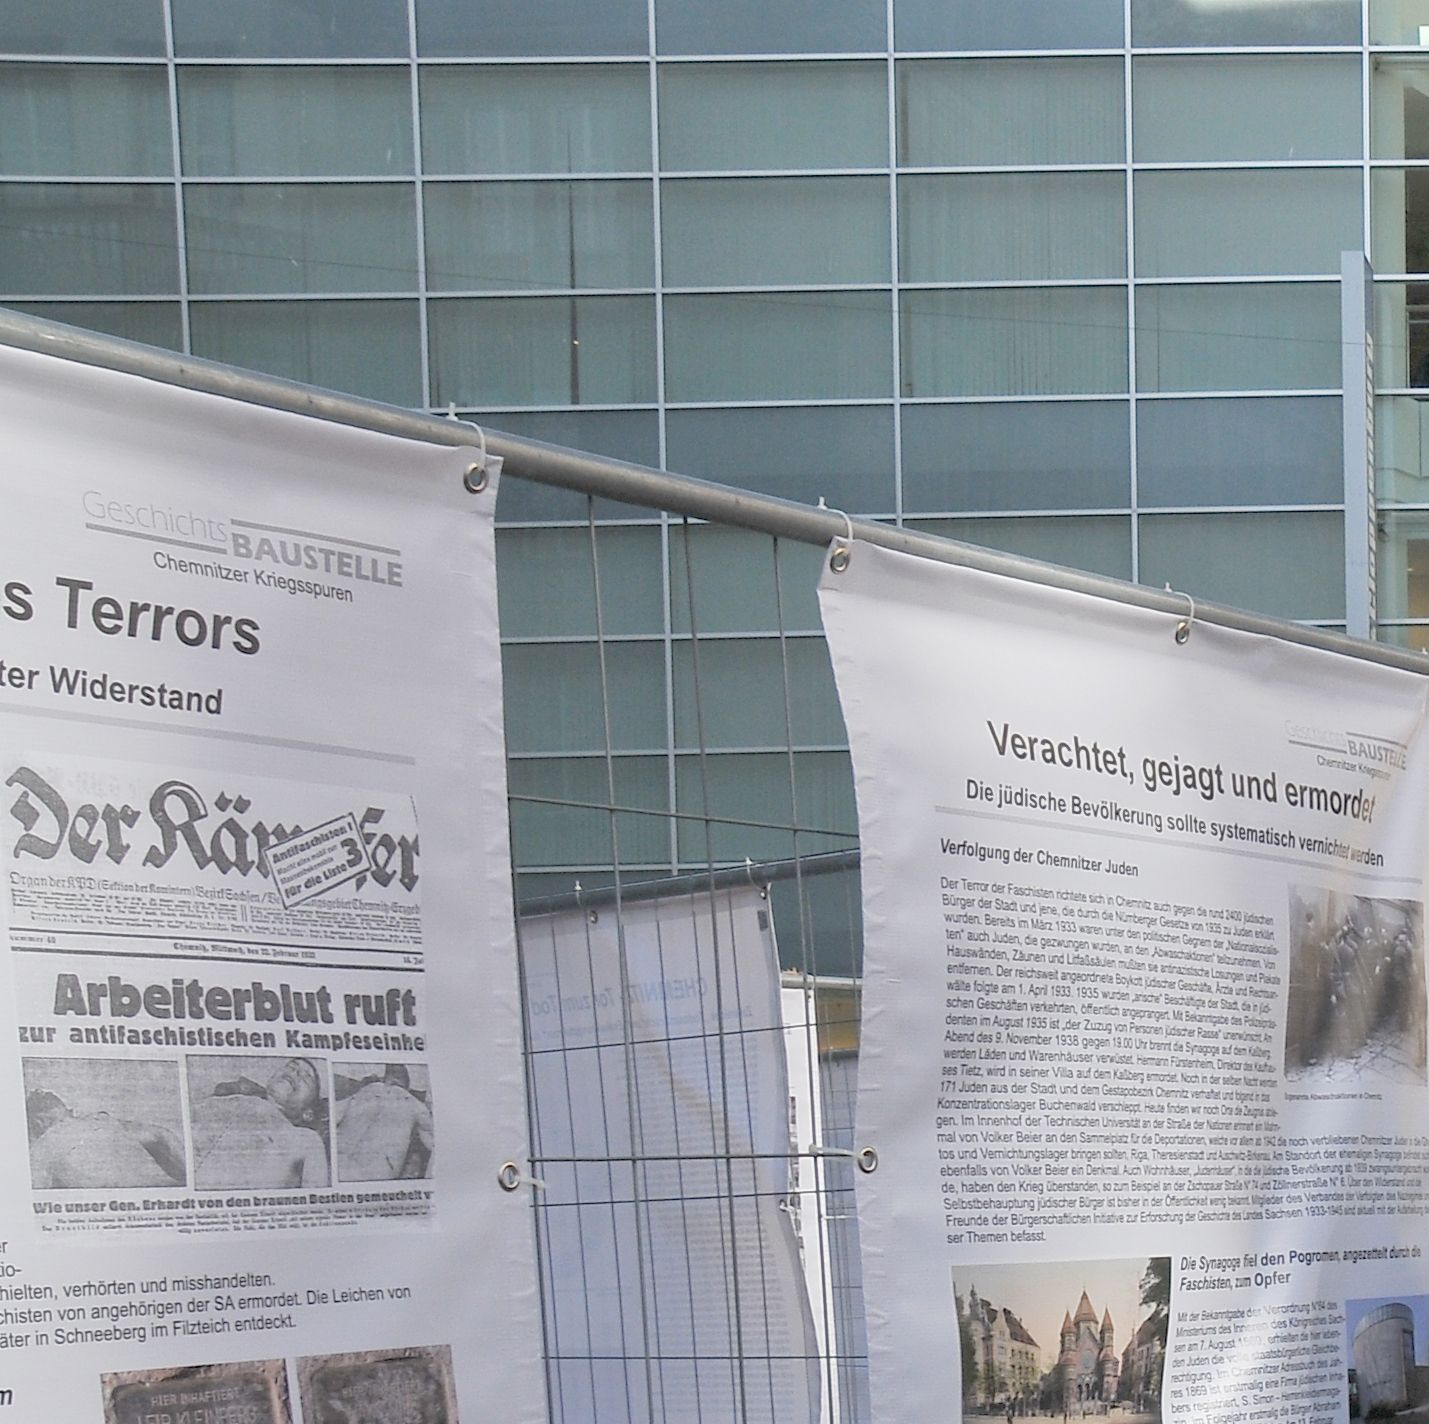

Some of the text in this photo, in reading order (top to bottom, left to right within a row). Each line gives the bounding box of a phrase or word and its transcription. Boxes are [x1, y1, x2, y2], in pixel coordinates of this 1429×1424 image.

[82, 490, 227, 542] Geschichts
[153, 551, 353, 603] Chemnitzer Kriegsspuren
[231, 532, 403, 588] BAUSTELLE
[55, 576, 261, 655] Terrors
[49, 665, 223, 715] Widerstand
[987, 721, 1136, 784] Verachtet,
[1142, 756, 1225, 800] gejagt
[1231, 772, 1278, 803] und
[5, 766, 420, 893] Der Kämfer
[966, 778, 994, 802] Die
[998, 784, 1066, 813] jüdische
[1071, 795, 1163, 833] Bevölkerung
[1167, 814, 1206, 835] sollte
[1210, 822, 1296, 848] systematisch
[340, 837, 363, 868] 3
[940, 838, 1139, 877] Verfolgung der Chemnitzer Juden
[304, 874, 323, 890] die
[53, 973, 417, 1027] Arbeiterblut ruft
[18, 1026, 57, 1043] zur
[69, 1025, 276, 1048] antifaschistischen
[1179, 1275, 1233, 1292] Faschisten,
[1254, 1270, 1291, 1289] Opfer
[1180, 1256, 1197, 1271] Die
[1198, 1255, 1241, 1273] Synagoge
[1243, 1253, 1258, 1268] fiel
[1260, 1252, 1285, 1267] den
[57, 1307, 86, 1321] von
[90, 1300, 183, 1322] angehörigen
[186, 1297, 210, 1313] der
[214, 1295, 236, 1312] SA
[306, 1289, 329, 1306] Die
[331, 1287, 385, 1304] Leichen
[387, 1287, 412, 1300] von
[63, 1280, 136, 1298] verhörten
[140, 1276, 168, 1294] und
[172, 1273, 276, 1291] misshandelten.
[34, 1330, 50, 1346] in
[54, 1325, 147, 1345] Schneeberg
[150, 1322, 169, 1338] im
[172, 1318, 231, 1336] Filzteich
